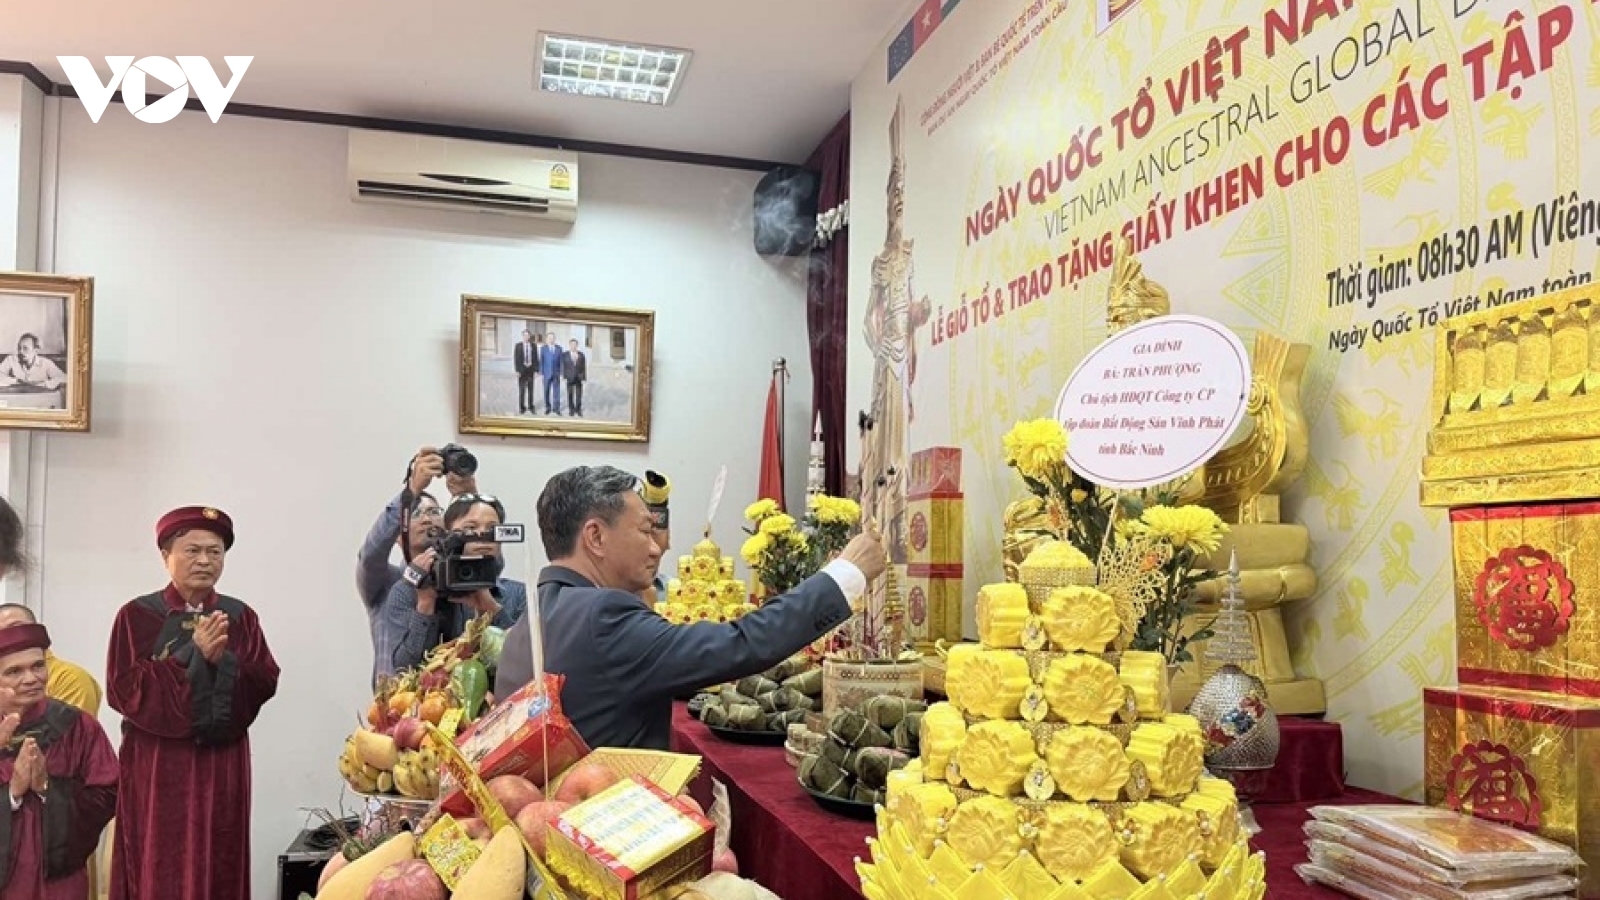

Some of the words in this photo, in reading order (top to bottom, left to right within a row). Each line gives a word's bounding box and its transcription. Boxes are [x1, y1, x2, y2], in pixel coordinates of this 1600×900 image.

[966, 181, 1022, 247] NGÀY
[1027, 125, 1103, 206] QUỐC
[1111, 76, 1155, 151] TỔ
[1164, 26, 1250, 117] VIỆT
[1265, 0, 1354, 59] NA
[1044, 169, 1127, 240] VIETNAM
[1133, 83, 1279, 193] ANCESTRAL
[1290, 0, 1435, 104] GLOBAL
[993, 287, 1004, 319] &
[1008, 262, 1052, 311] TRAO
[1057, 231, 1114, 291] TẶNG
[1184, 155, 1263, 232] KHEN
[1274, 115, 1351, 188] CHO
[1363, 64, 1449, 147] CÁC
[1462, 5, 1574, 102] TẬP
[1326, 261, 1363, 309] Thời
[1367, 254, 1412, 309] gian:
[1417, 225, 1480, 283] 08h30
[1485, 210, 1523, 265] AM
[1532, 190, 1600, 259] (Viên
[1133, 343, 1151, 354] GIA
[1328, 326, 1368, 353] Ngày
[1372, 310, 1413, 342] Quốc
[1155, 389, 1182, 404] Công
[1184, 390, 1195, 405] ty
[1198, 387, 1216, 401] CP
[1198, 415, 1225, 429] Phát
[1139, 443, 1165, 455] Ninh
